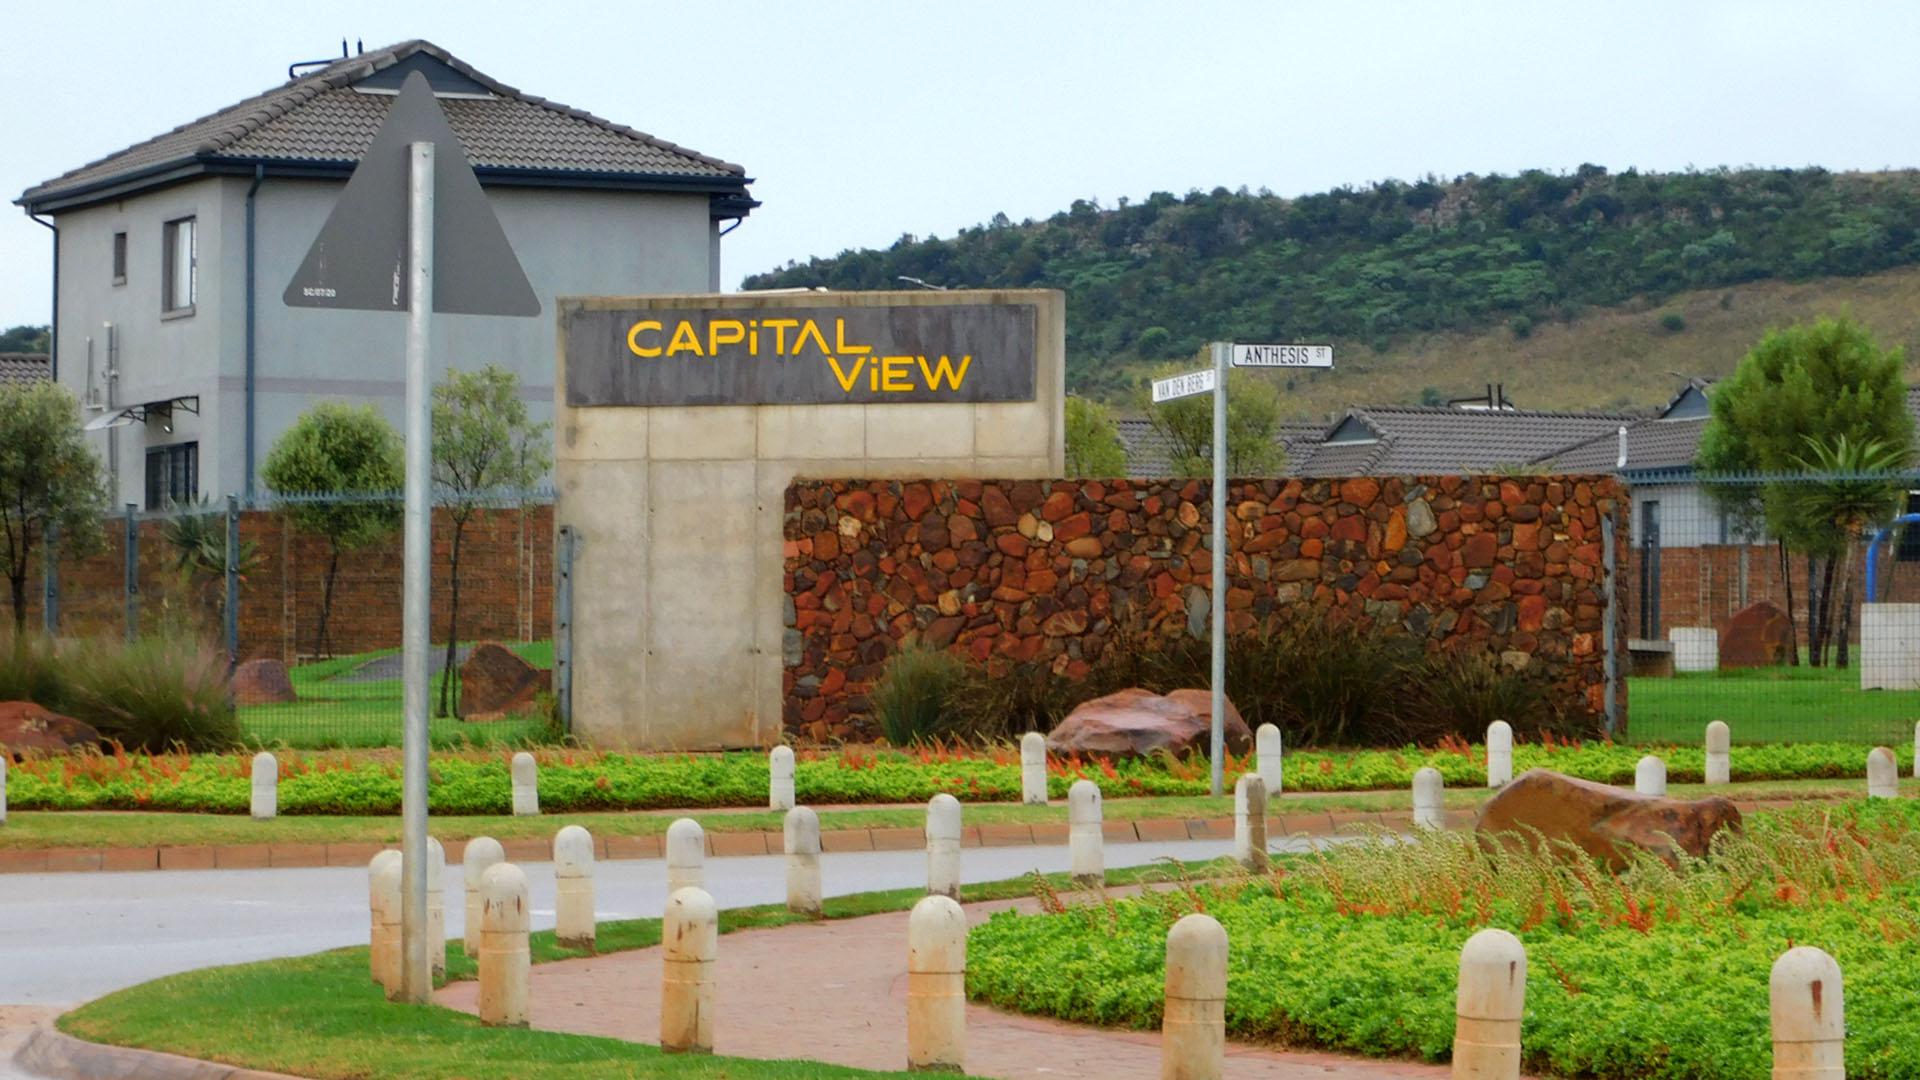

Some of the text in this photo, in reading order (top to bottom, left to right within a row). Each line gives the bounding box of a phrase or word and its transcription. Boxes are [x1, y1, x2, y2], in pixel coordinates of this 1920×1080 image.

[1245, 347, 1325, 364] ANTHESIS ST
[1157, 381, 1170, 399] VAN
[1172, 378, 1185, 397] DEN
